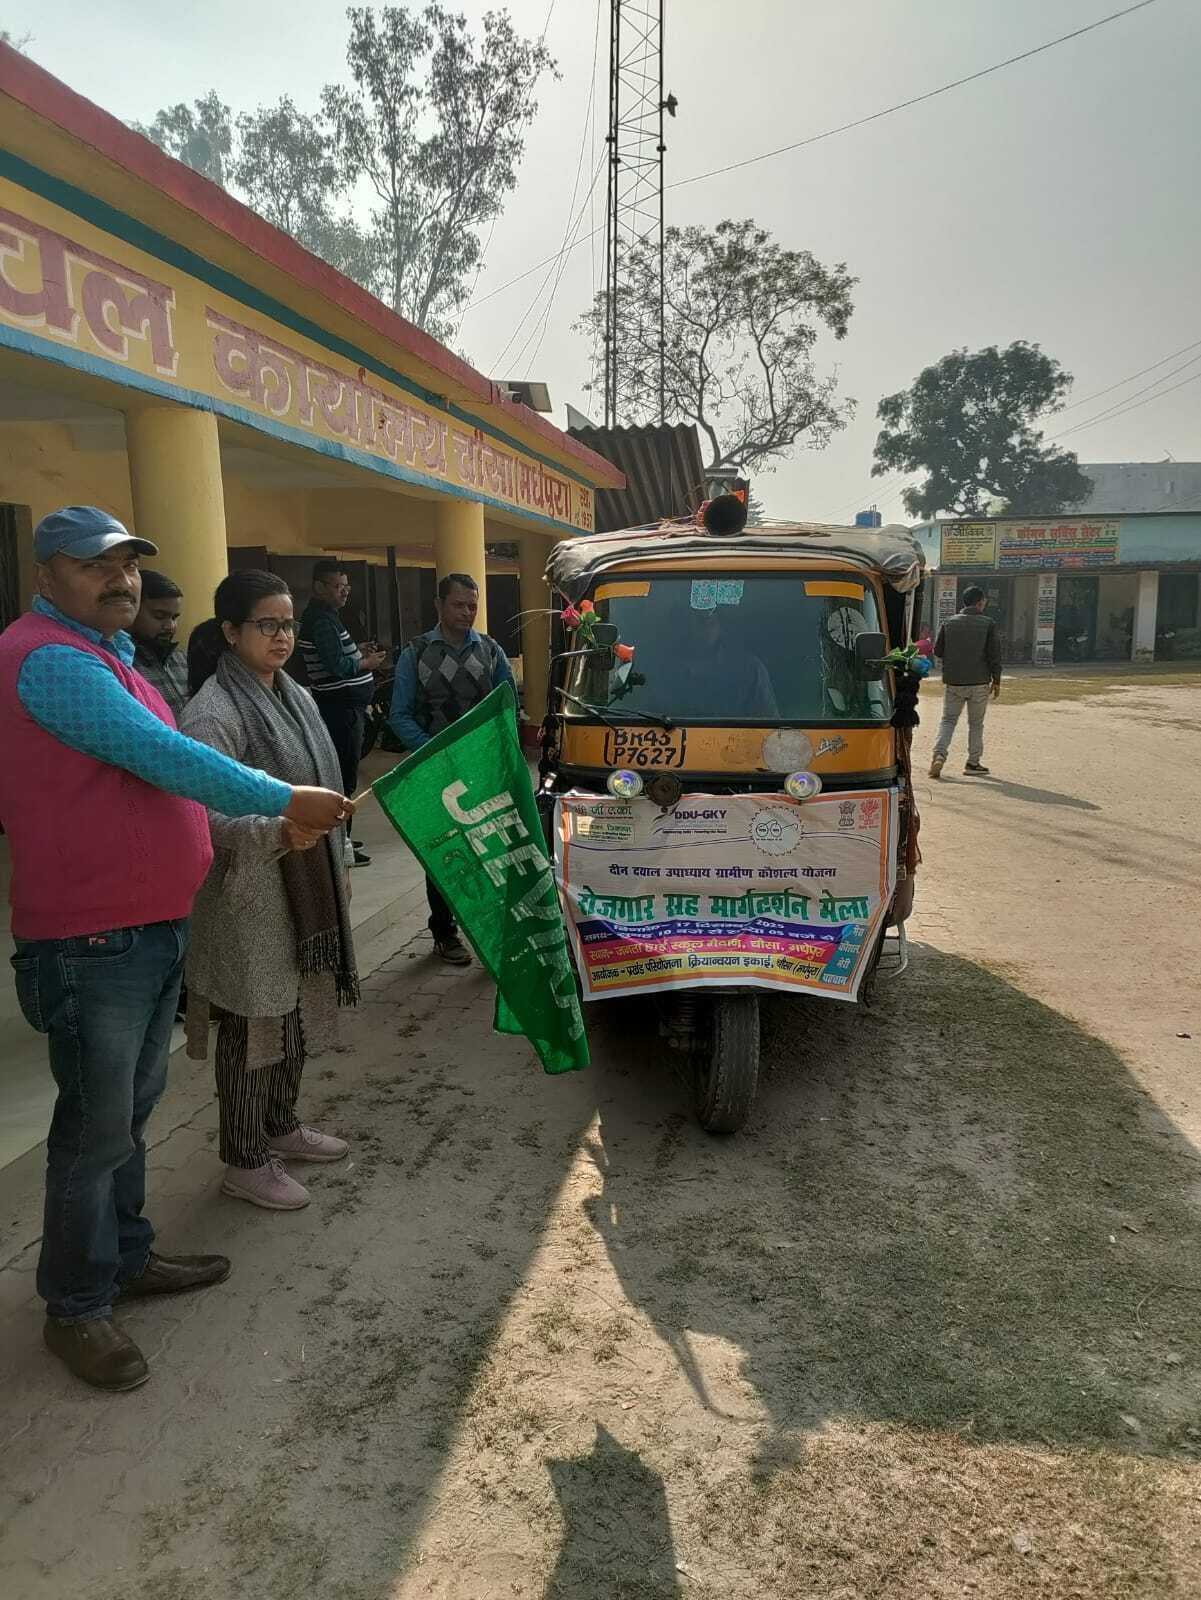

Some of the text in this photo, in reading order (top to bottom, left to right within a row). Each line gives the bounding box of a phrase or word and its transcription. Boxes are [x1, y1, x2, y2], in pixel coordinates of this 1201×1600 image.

[612, 747, 676, 766] P7627
[674, 809, 727, 820] DDU-GKY
[609, 863, 629, 877] दीन
[633, 866, 661, 878] दयाल
[665, 866, 711, 879] उपाध्याय
[715, 864, 753, 879] ग्रामीण
[801, 865, 836, 878] योजना
[577, 885, 870, 922] रोजगार सह मार्गदर्शन मेला
